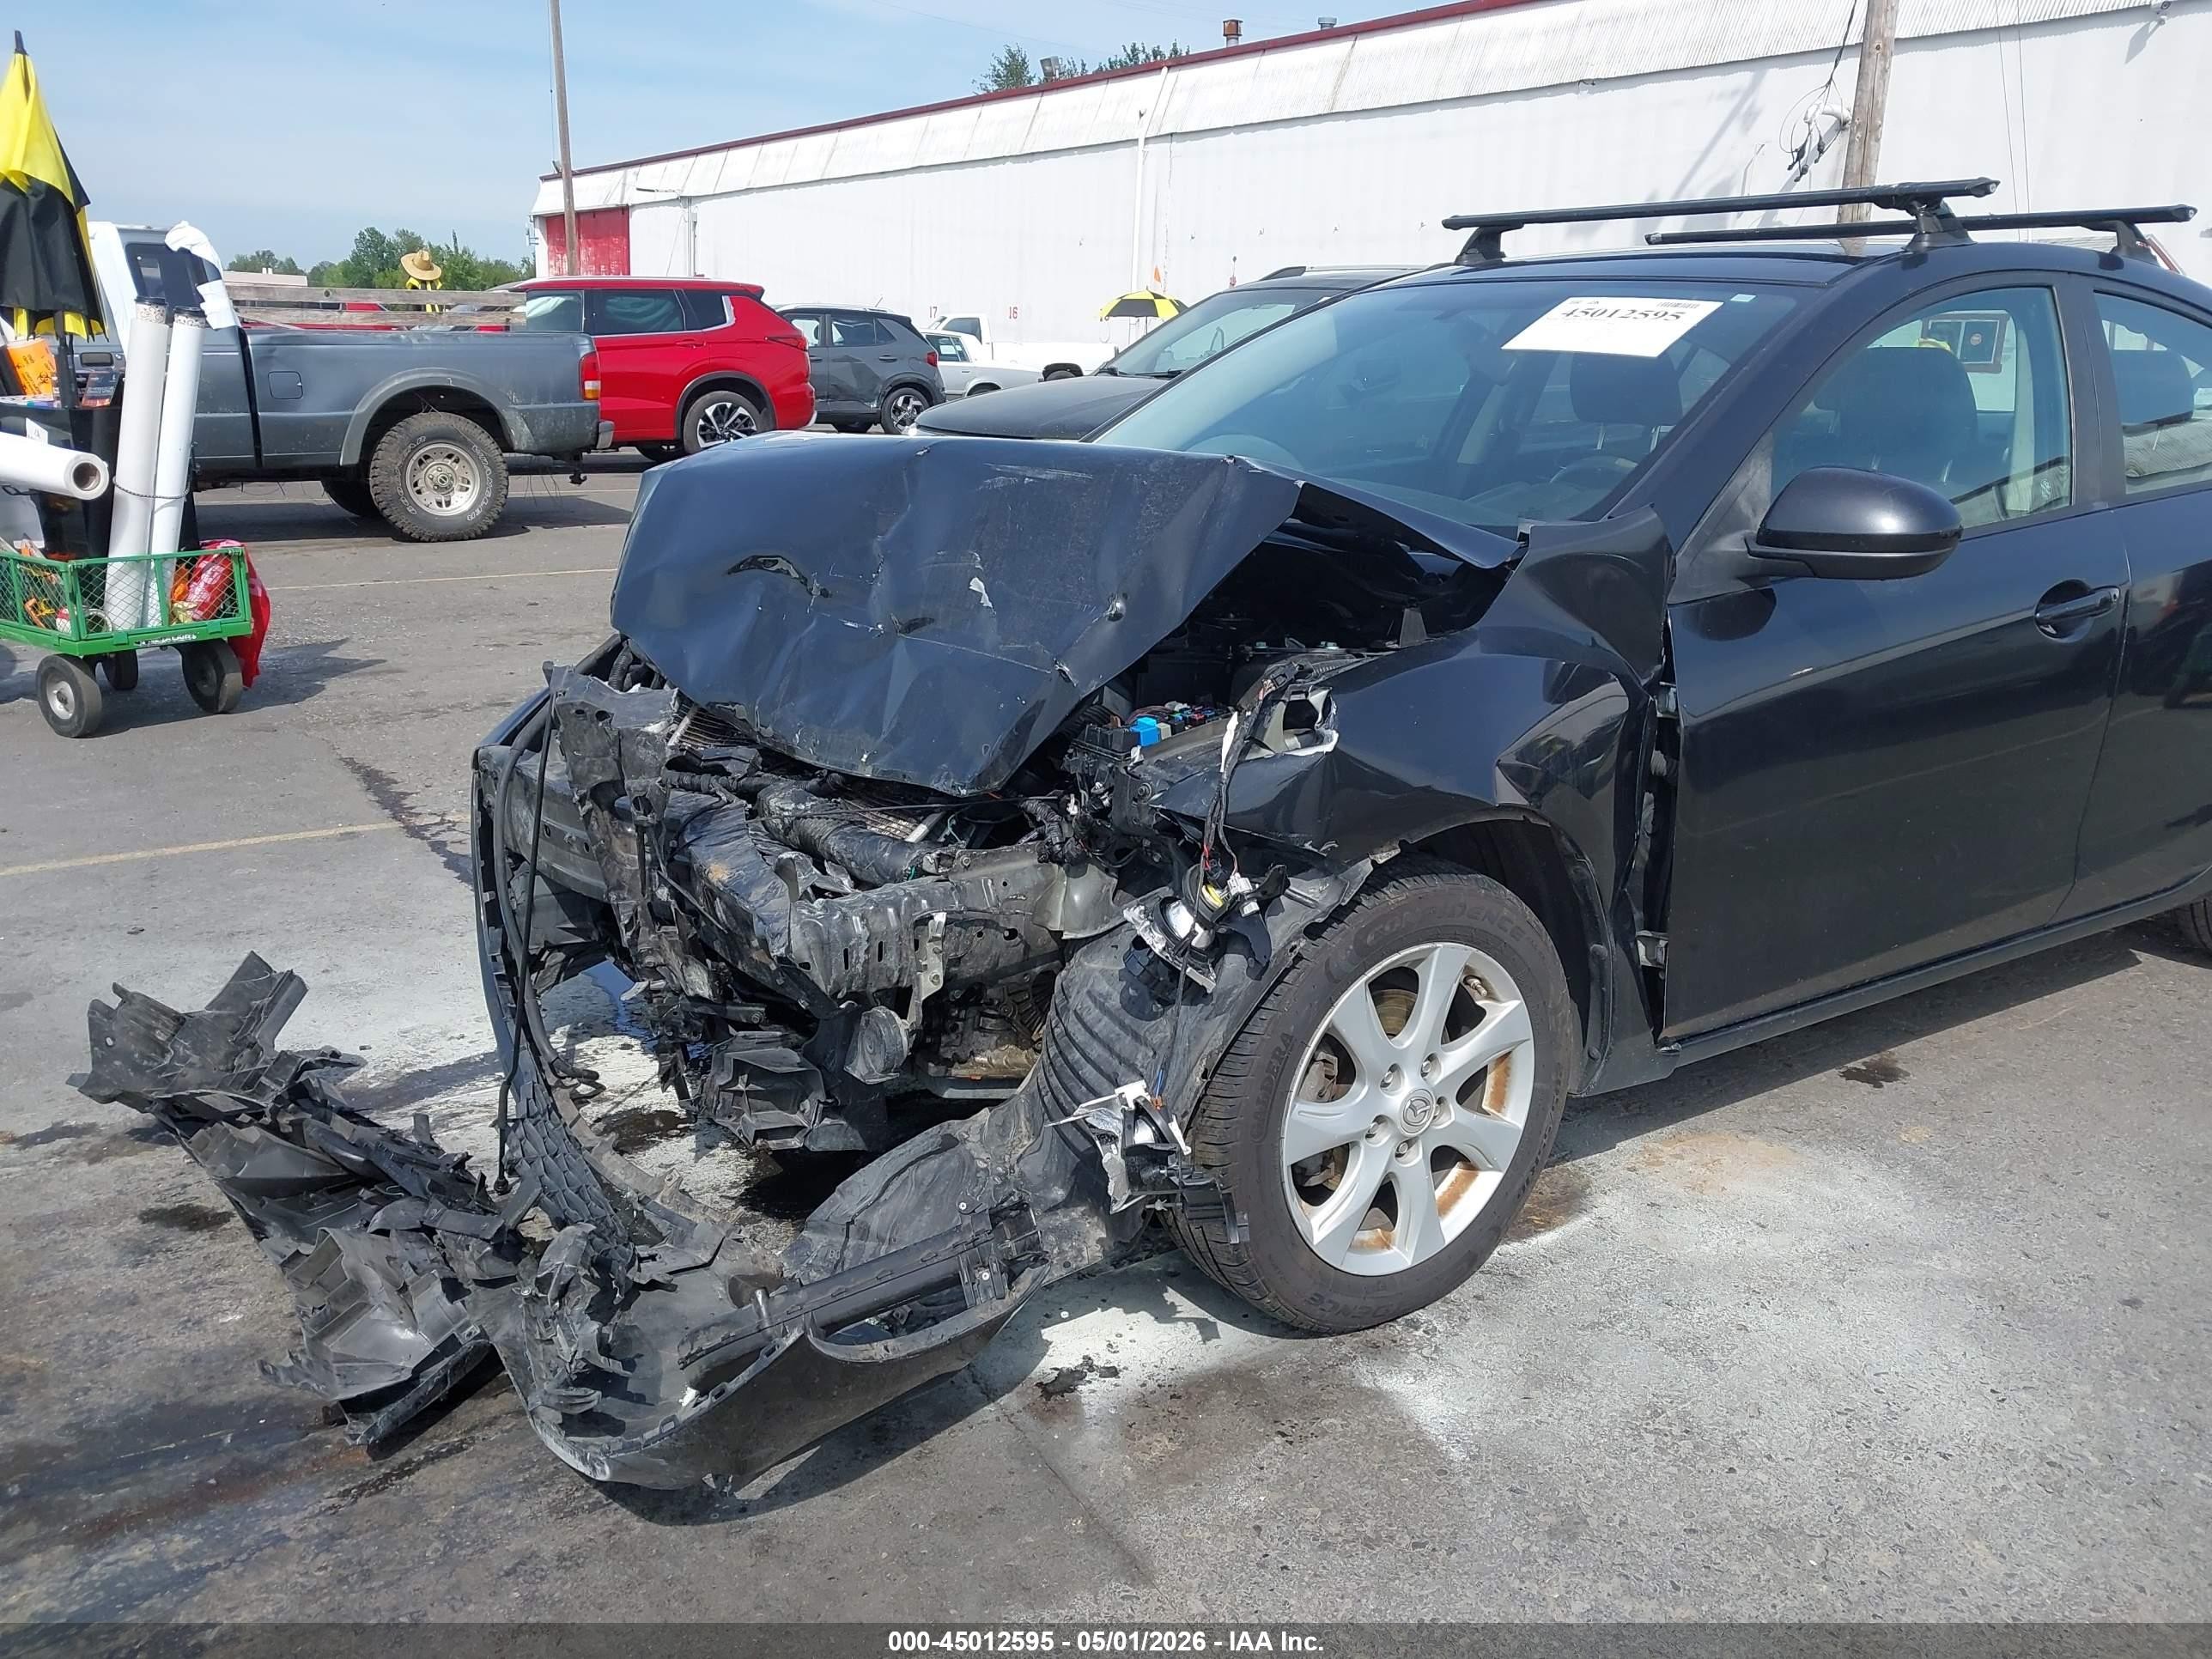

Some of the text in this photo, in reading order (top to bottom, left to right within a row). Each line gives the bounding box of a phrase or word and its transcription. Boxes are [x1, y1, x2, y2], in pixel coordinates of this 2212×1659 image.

[929, 306, 938, 319] 17
[1008, 306, 1018, 319] 16
[1561, 307, 1686, 321] 45012595
